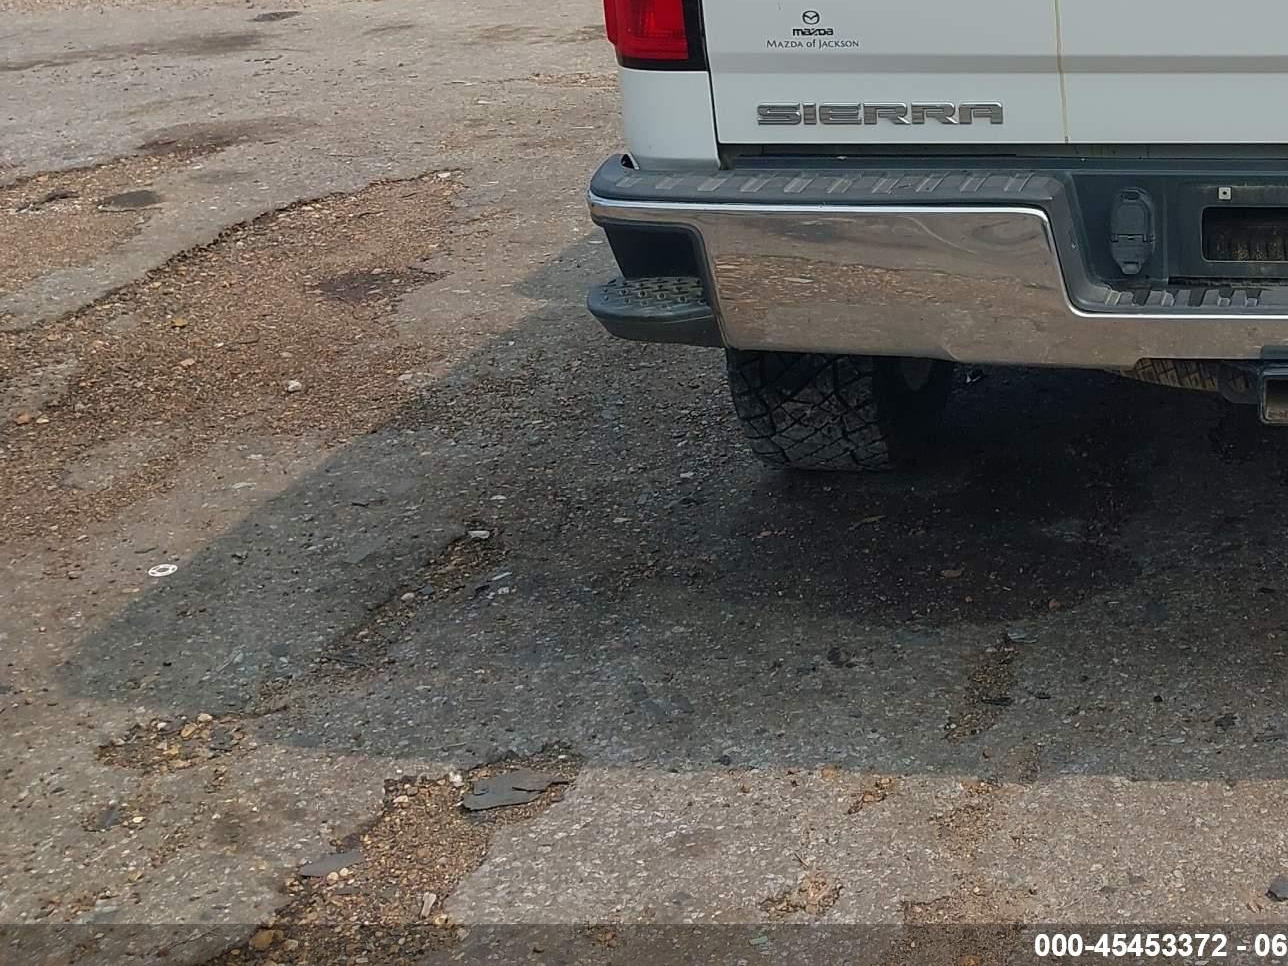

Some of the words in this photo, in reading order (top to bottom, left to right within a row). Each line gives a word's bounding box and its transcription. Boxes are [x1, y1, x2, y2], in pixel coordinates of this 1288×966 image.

[792, 28, 834, 36] mazda
[806, 39, 816, 48] of
[757, 102, 1004, 125] SIERRA
